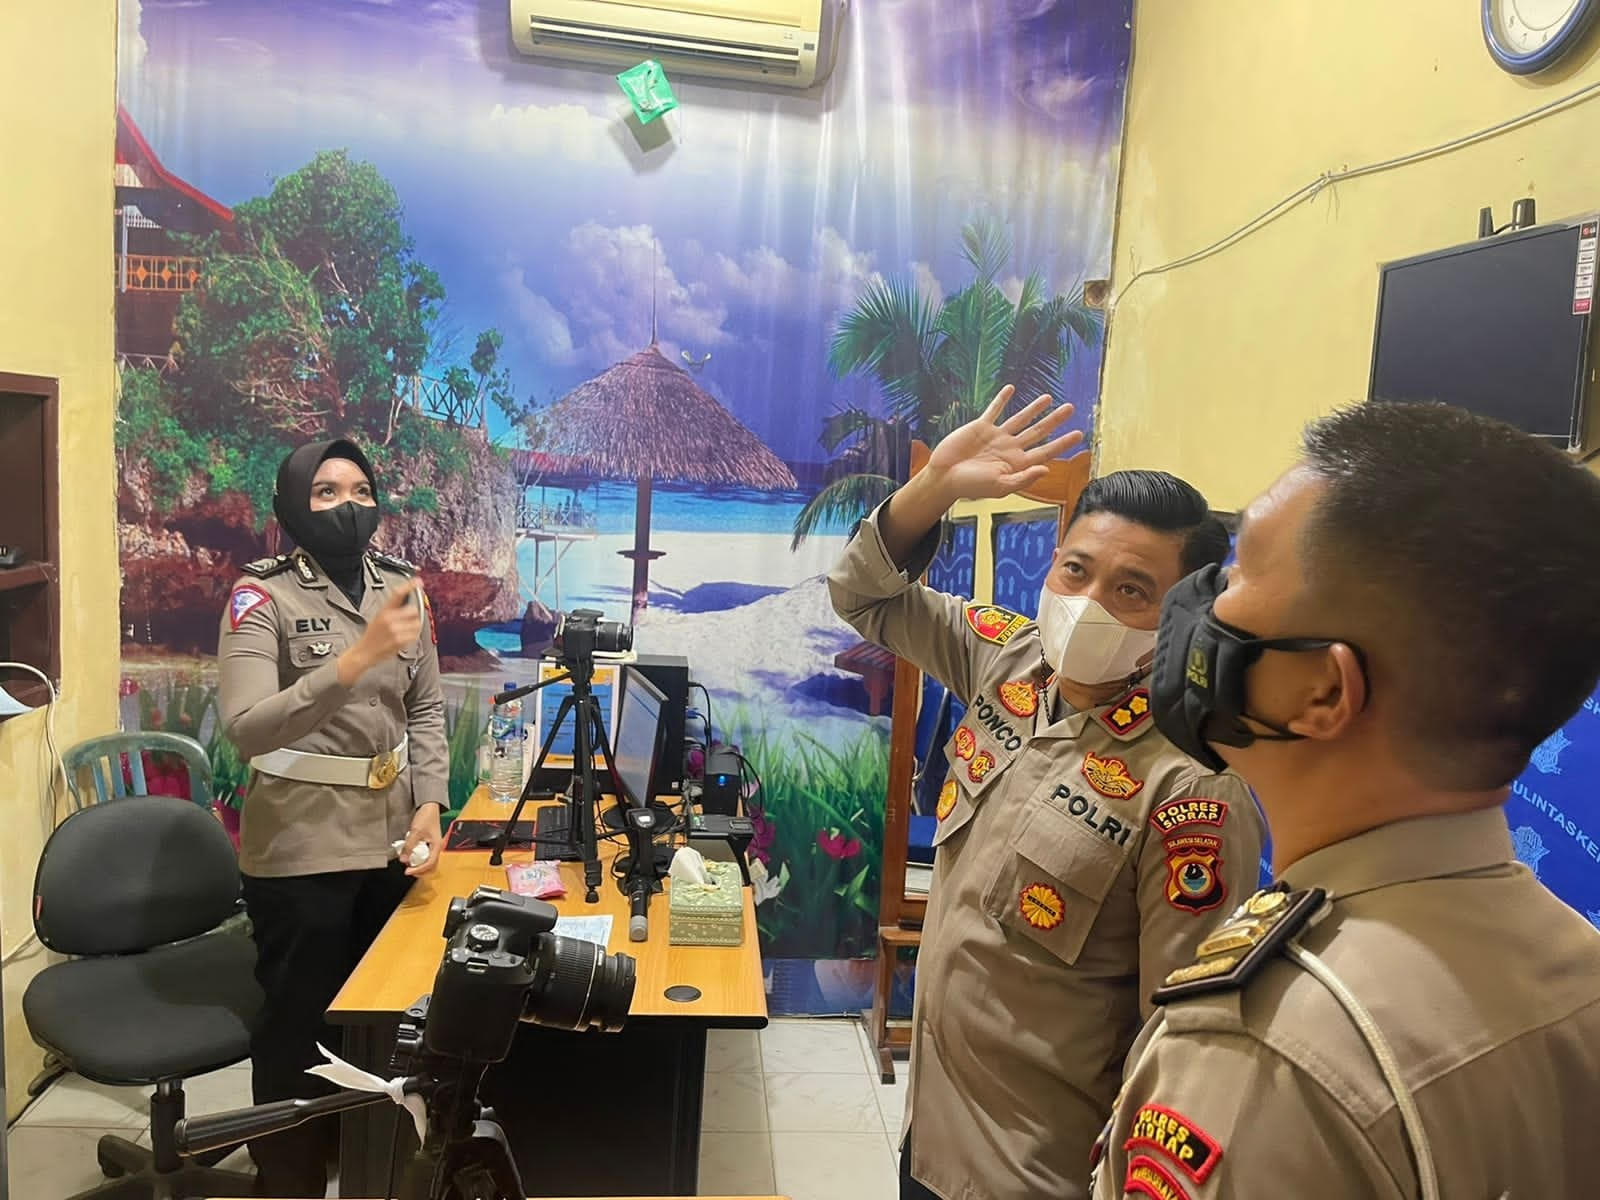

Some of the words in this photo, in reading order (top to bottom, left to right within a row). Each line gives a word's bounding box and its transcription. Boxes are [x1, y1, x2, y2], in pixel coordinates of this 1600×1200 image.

[296, 618, 331, 632] ELY
[974, 694, 1021, 751] PONCO
[1050, 784, 1131, 846] POLRI
[1157, 802, 1218, 822] POLRES
[1163, 812, 1217, 828] SIDRAP
[1510, 780, 1600, 863] ULINTASKE
[1133, 1123, 1193, 1159] SIDRAP
[1139, 1109, 1190, 1143] POLRES
